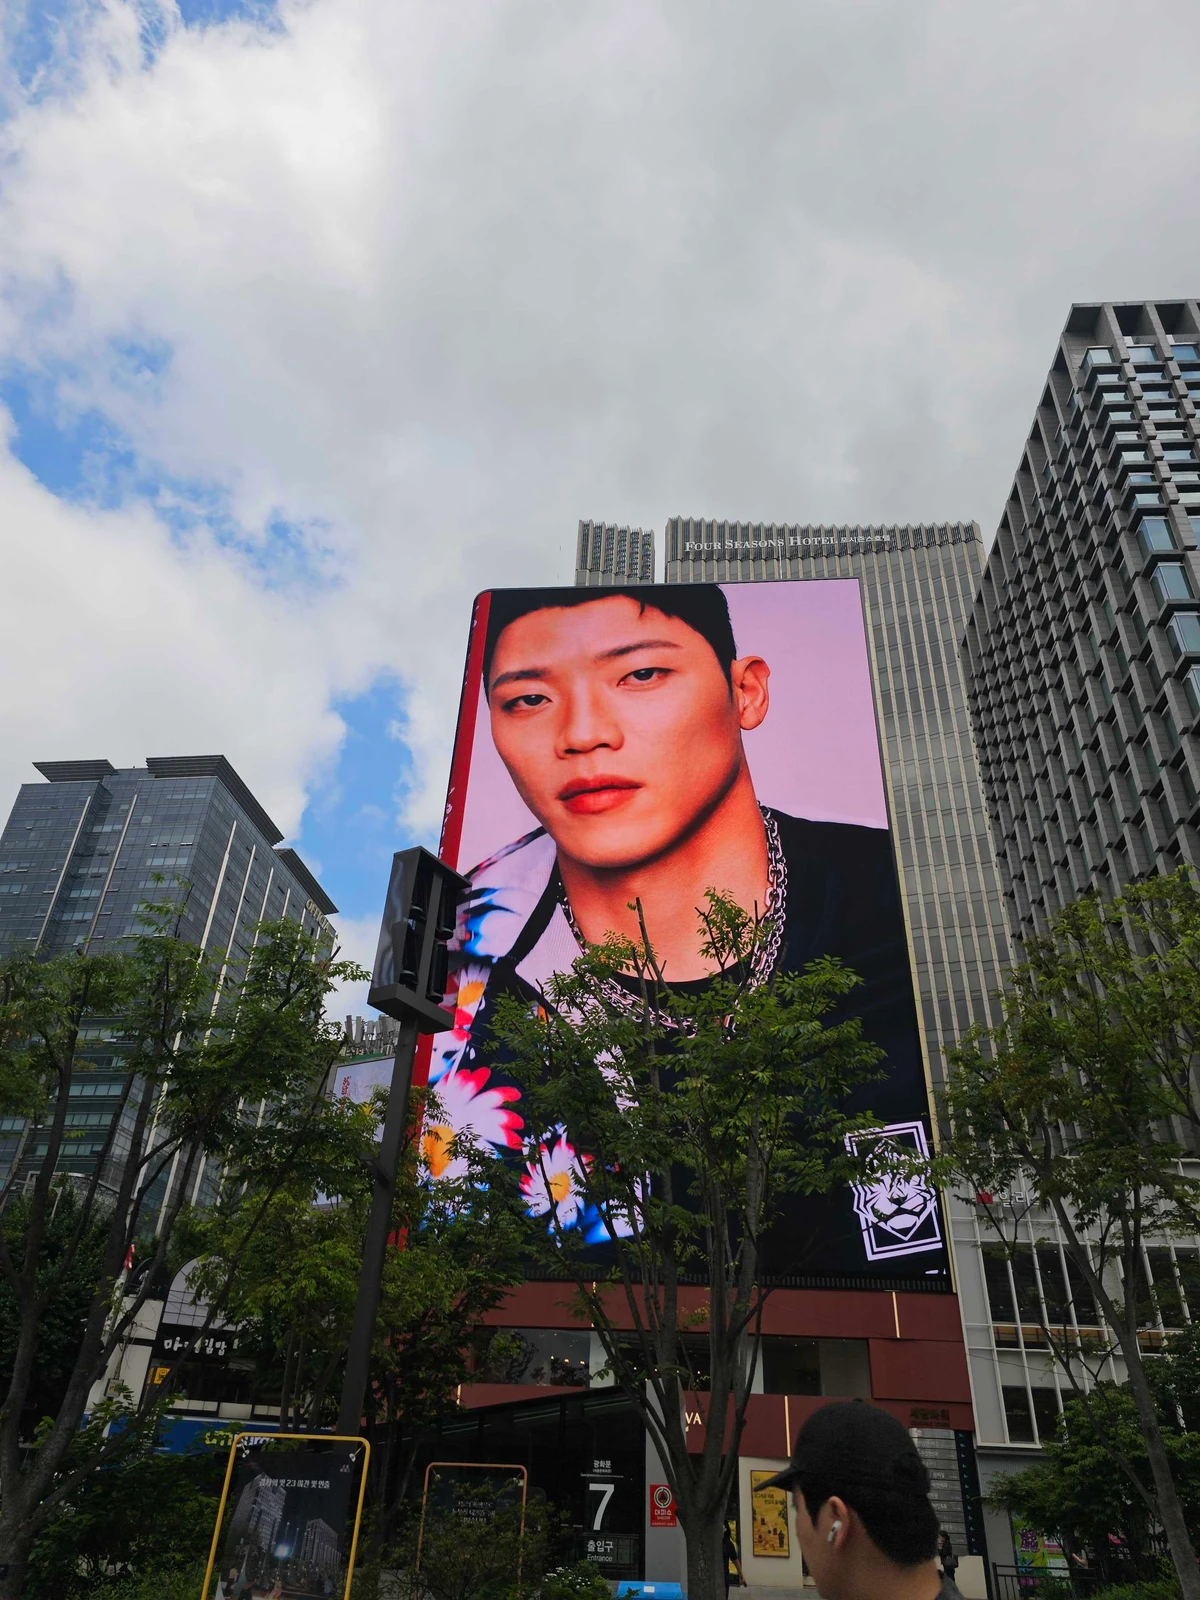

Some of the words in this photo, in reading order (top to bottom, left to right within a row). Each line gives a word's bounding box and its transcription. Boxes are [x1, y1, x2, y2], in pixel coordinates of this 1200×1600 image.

[684, 541, 722, 552] FOUR
[724, 538, 785, 550] SEASONS
[788, 536, 838, 547] HOTEL
[286, 1479, 296, 1488] 23
[588, 1482, 615, 1531] 7
[654, 1508, 673, 1516] 대피소
[587, 1539, 614, 1553] 출입구
[587, 1553, 613, 1562] Entrance
